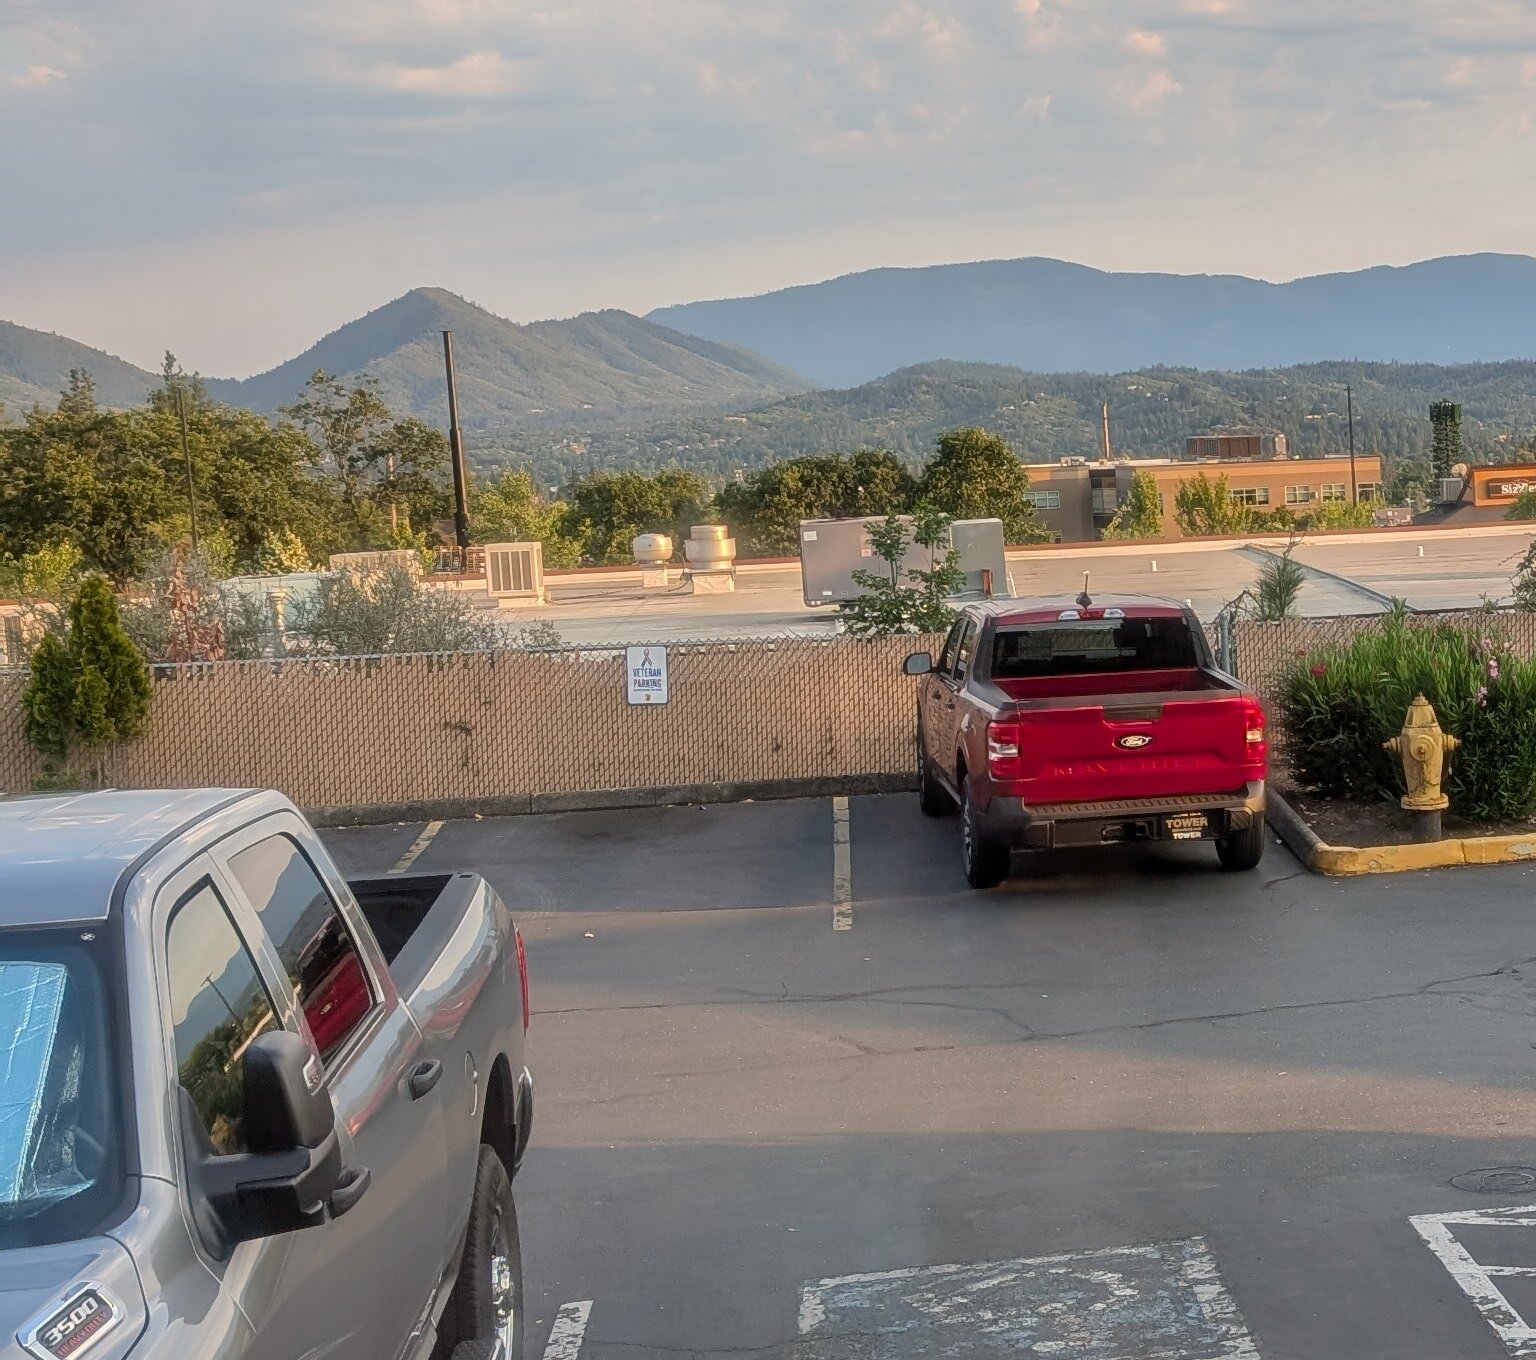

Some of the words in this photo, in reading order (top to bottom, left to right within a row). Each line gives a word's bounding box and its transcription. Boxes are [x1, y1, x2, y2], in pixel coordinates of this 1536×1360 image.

[633, 667, 662, 677] VETERAN
[633, 679, 662, 688] PARKING
[1166, 816, 1208, 828] TOWER
[44, 1298, 98, 1346] 3500
